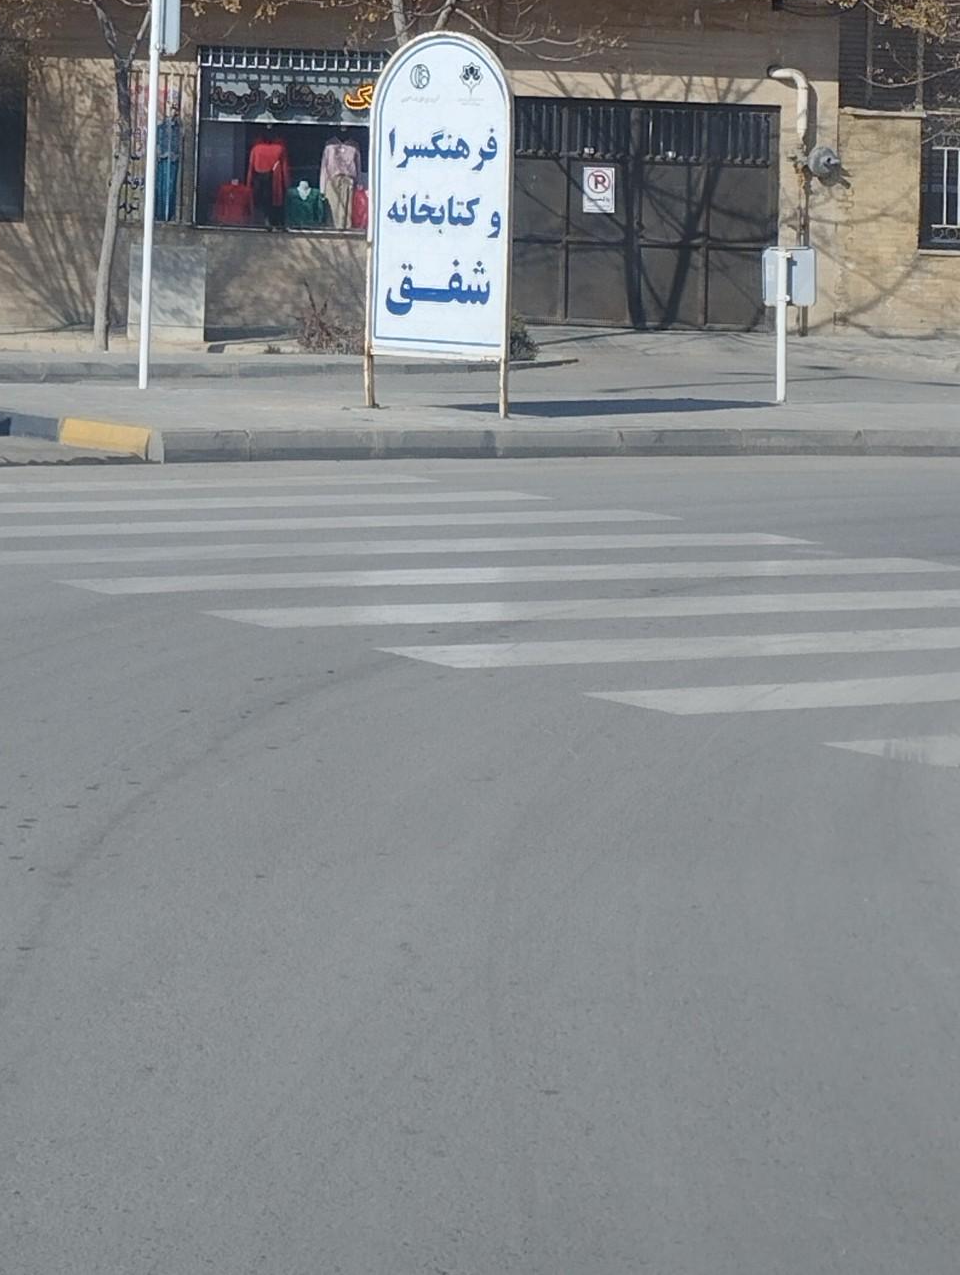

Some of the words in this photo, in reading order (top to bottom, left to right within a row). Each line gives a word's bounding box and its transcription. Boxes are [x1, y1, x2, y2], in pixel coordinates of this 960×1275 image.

[389, 127, 498, 171] فرهنگسرا
[387, 193, 480, 235] کتابخانه
[487, 212, 502, 239] و
[385, 259, 491, 316] شفق
